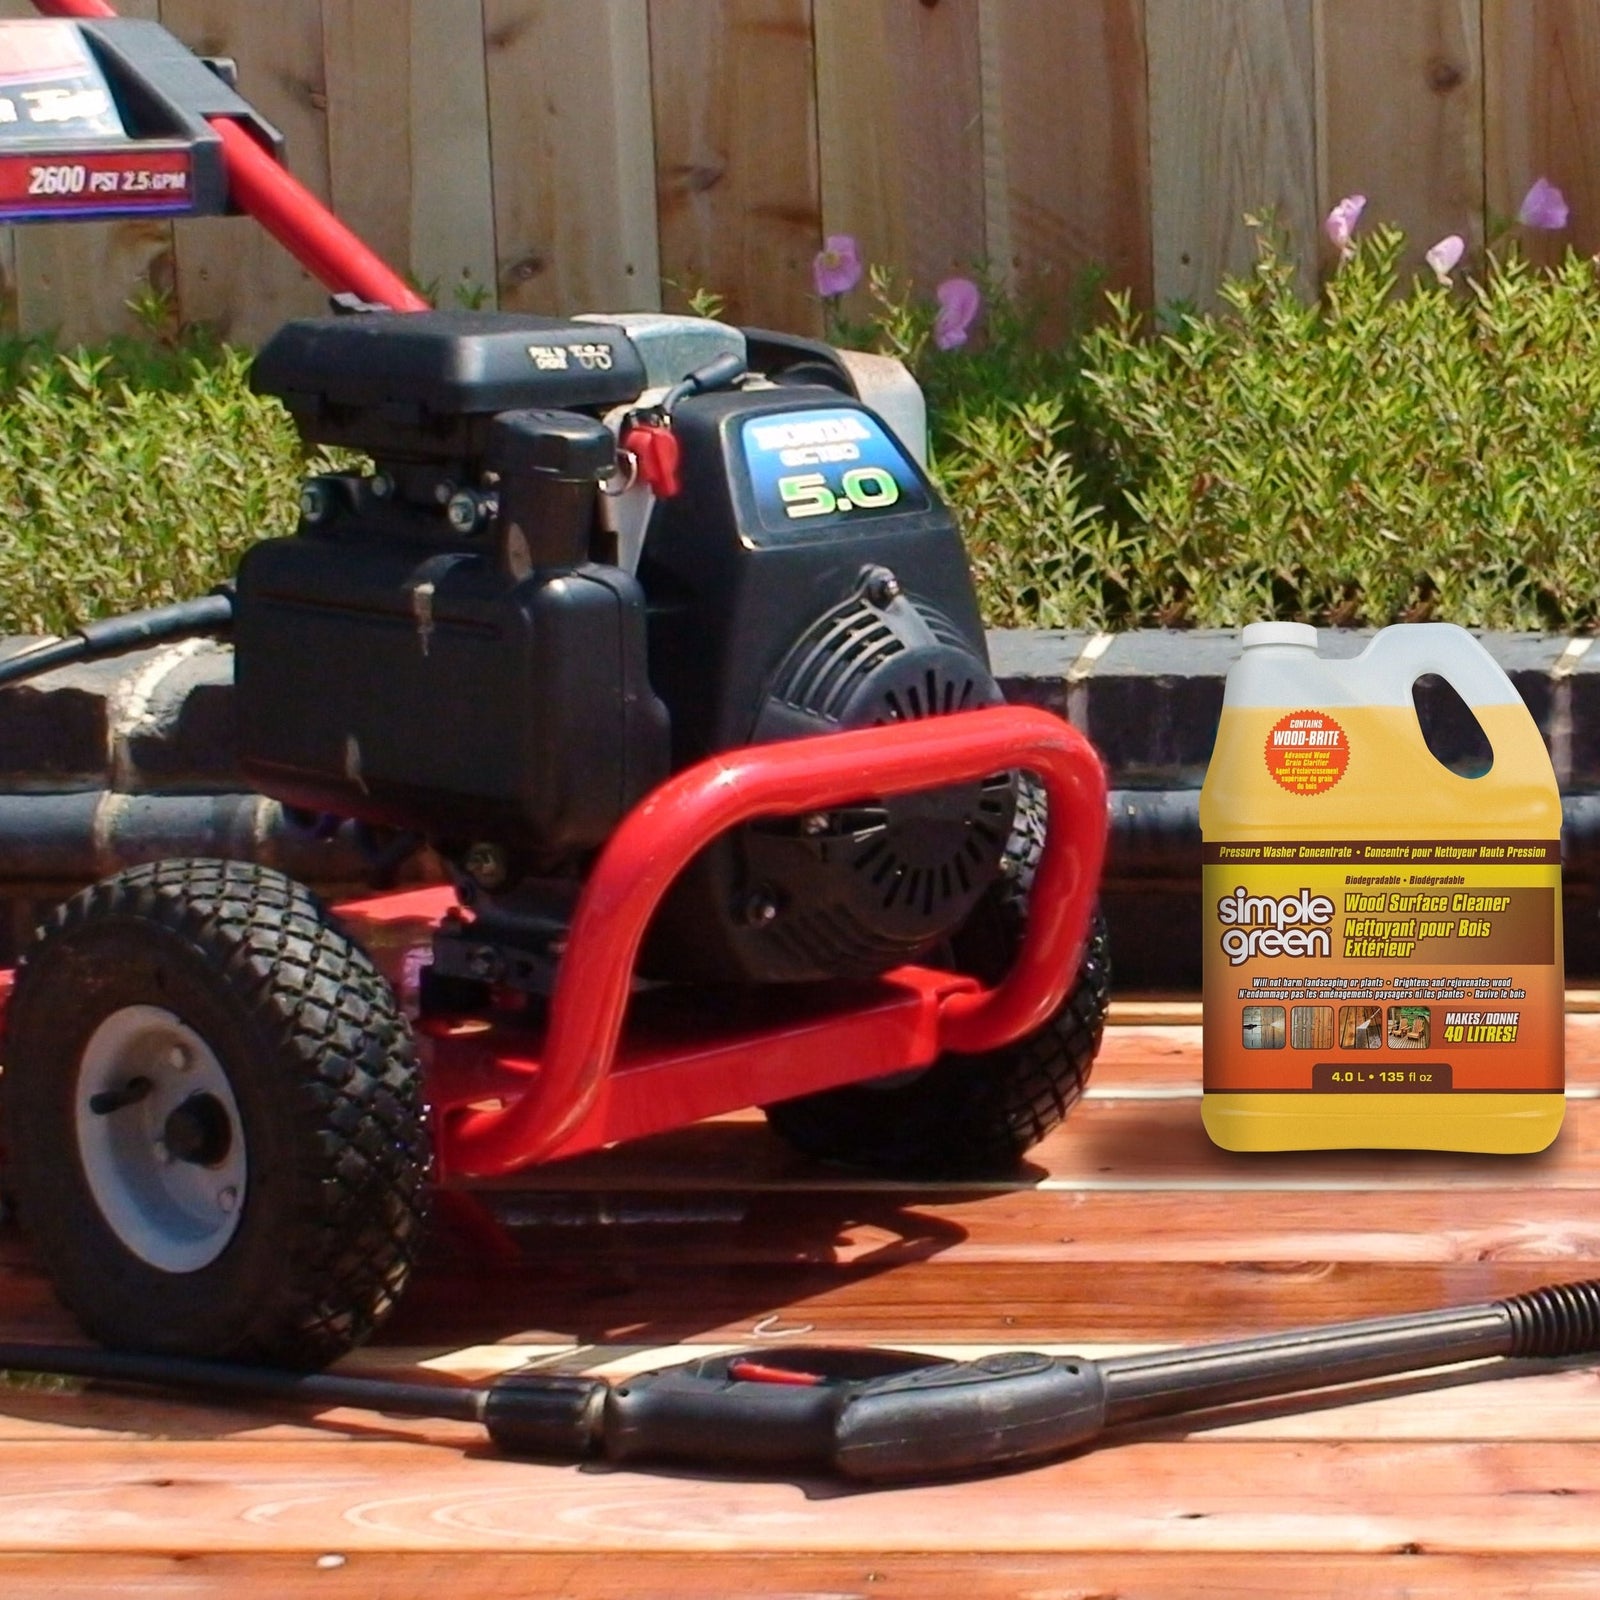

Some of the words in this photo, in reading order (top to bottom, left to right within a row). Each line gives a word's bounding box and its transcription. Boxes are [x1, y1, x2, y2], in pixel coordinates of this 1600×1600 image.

[28, 165, 86, 195] 2600
[90, 171, 119, 192] PSI
[778, 467, 900, 519] 5.0
[1290, 720, 1323, 729] CONTAINS
[1273, 730, 1340, 746] WOOD-BRITE
[1219, 846, 1261, 858] Pressure
[1263, 846, 1297, 858] Washer
[1298, 846, 1352, 858] Concentrate
[1364, 846, 1409, 858] Concentré
[1411, 848, 1432, 860] pour
[1434, 846, 1477, 860] Nettoyeur
[1479, 846, 1505, 858] Haute
[1506, 846, 1546, 858] Pression
[1345, 875, 1401, 887] Biodegradable
[1409, 875, 1465, 887] Biodégradable
[1217, 886, 1335, 931] simple
[1344, 893, 1387, 912] Wood
[1388, 893, 1448, 912] Surface
[1451, 893, 1511, 912] Cleaner
[1344, 918, 1417, 940] Nettoyant
[1417, 921, 1455, 940] pour
[1457, 918, 1491, 938] Bois
[1220, 927, 1332, 966] green
[1344, 938, 1415, 958] Extérieur
[1252, 977, 1267, 987] Will
[1269, 977, 1282, 987] not
[1283, 977, 1302, 987] harm
[1304, 977, 1348, 989] landscaping
[1349, 979, 1359, 987] or
[1360, 977, 1384, 989] plants
[1393, 977, 1430, 989] Brightens
[1431, 977, 1445, 988] and
[1446, 977, 1491, 989] rejuvenates
[1492, 977, 1512, 988] wood
[1238, 989, 1289, 1000] N'endommage
[1290, 990, 1304, 1000] pas
[1305, 989, 1318, 999] les
[1319, 988, 1373, 1000] aménagements
[1374, 990, 1413, 1000] paysagers
[1414, 989, 1423, 999] ni
[1424, 989, 1436, 999] les
[1436, 989, 1465, 1000] plantes
[1474, 989, 1499, 999] Ravive
[1500, 989, 1509, 999] le
[1509, 989, 1525, 999] bois
[1445, 1012, 1520, 1026] MAKES/DONNE
[1444, 1025, 1464, 1043] 40
[1466, 1025, 1518, 1043] LITRES!
[1331, 1071, 1354, 1082] 4.0
[1357, 1072, 1365, 1082] L
[1379, 1071, 1405, 1082] 135
[1408, 1071, 1416, 1082] fl
[1419, 1074, 1433, 1082] oz
